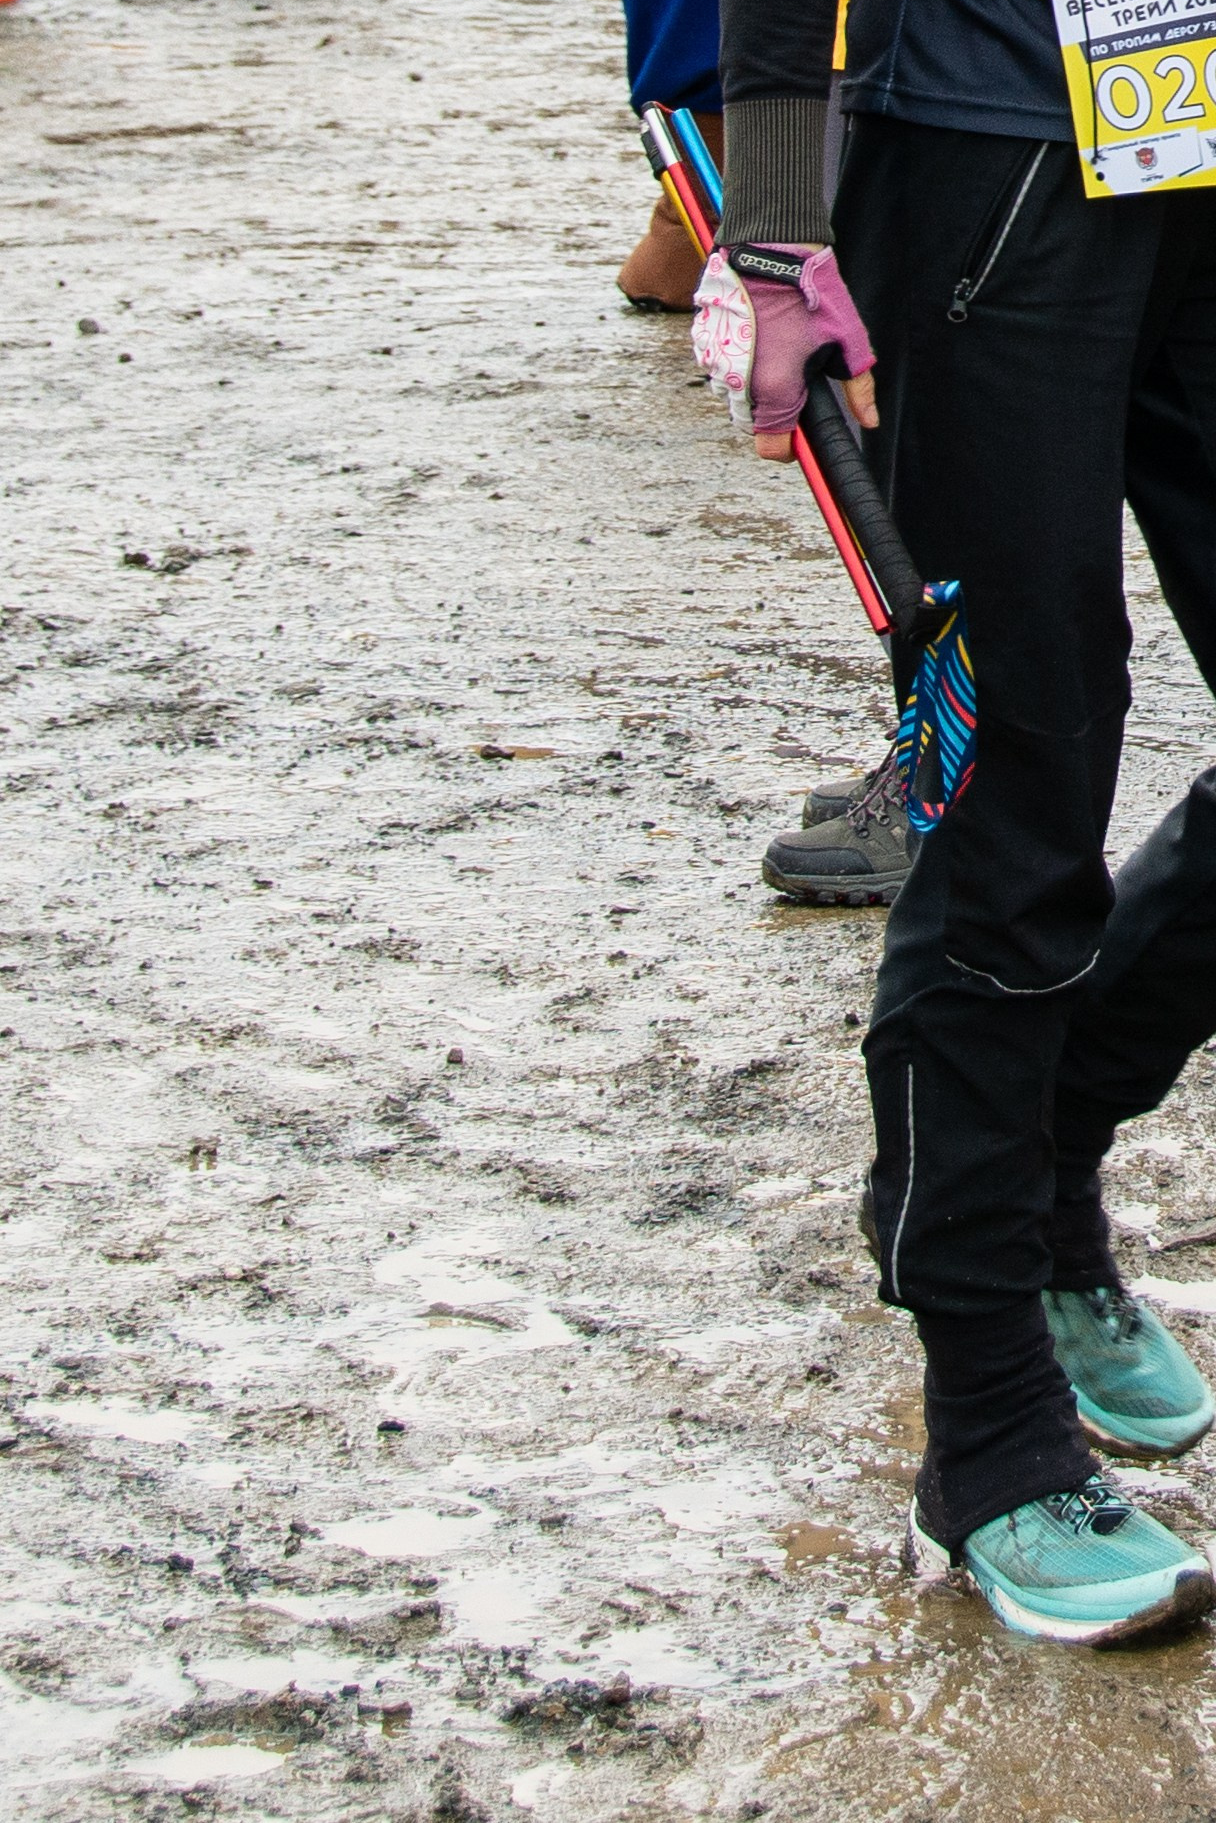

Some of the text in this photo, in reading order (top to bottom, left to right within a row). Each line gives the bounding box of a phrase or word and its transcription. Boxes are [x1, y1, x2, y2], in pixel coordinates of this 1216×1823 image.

[1090, 43, 1109, 57] ПО
[1111, 32, 1162, 52] ТРОПАМ
[1164, 22, 1201, 40] ДЕРСУ
